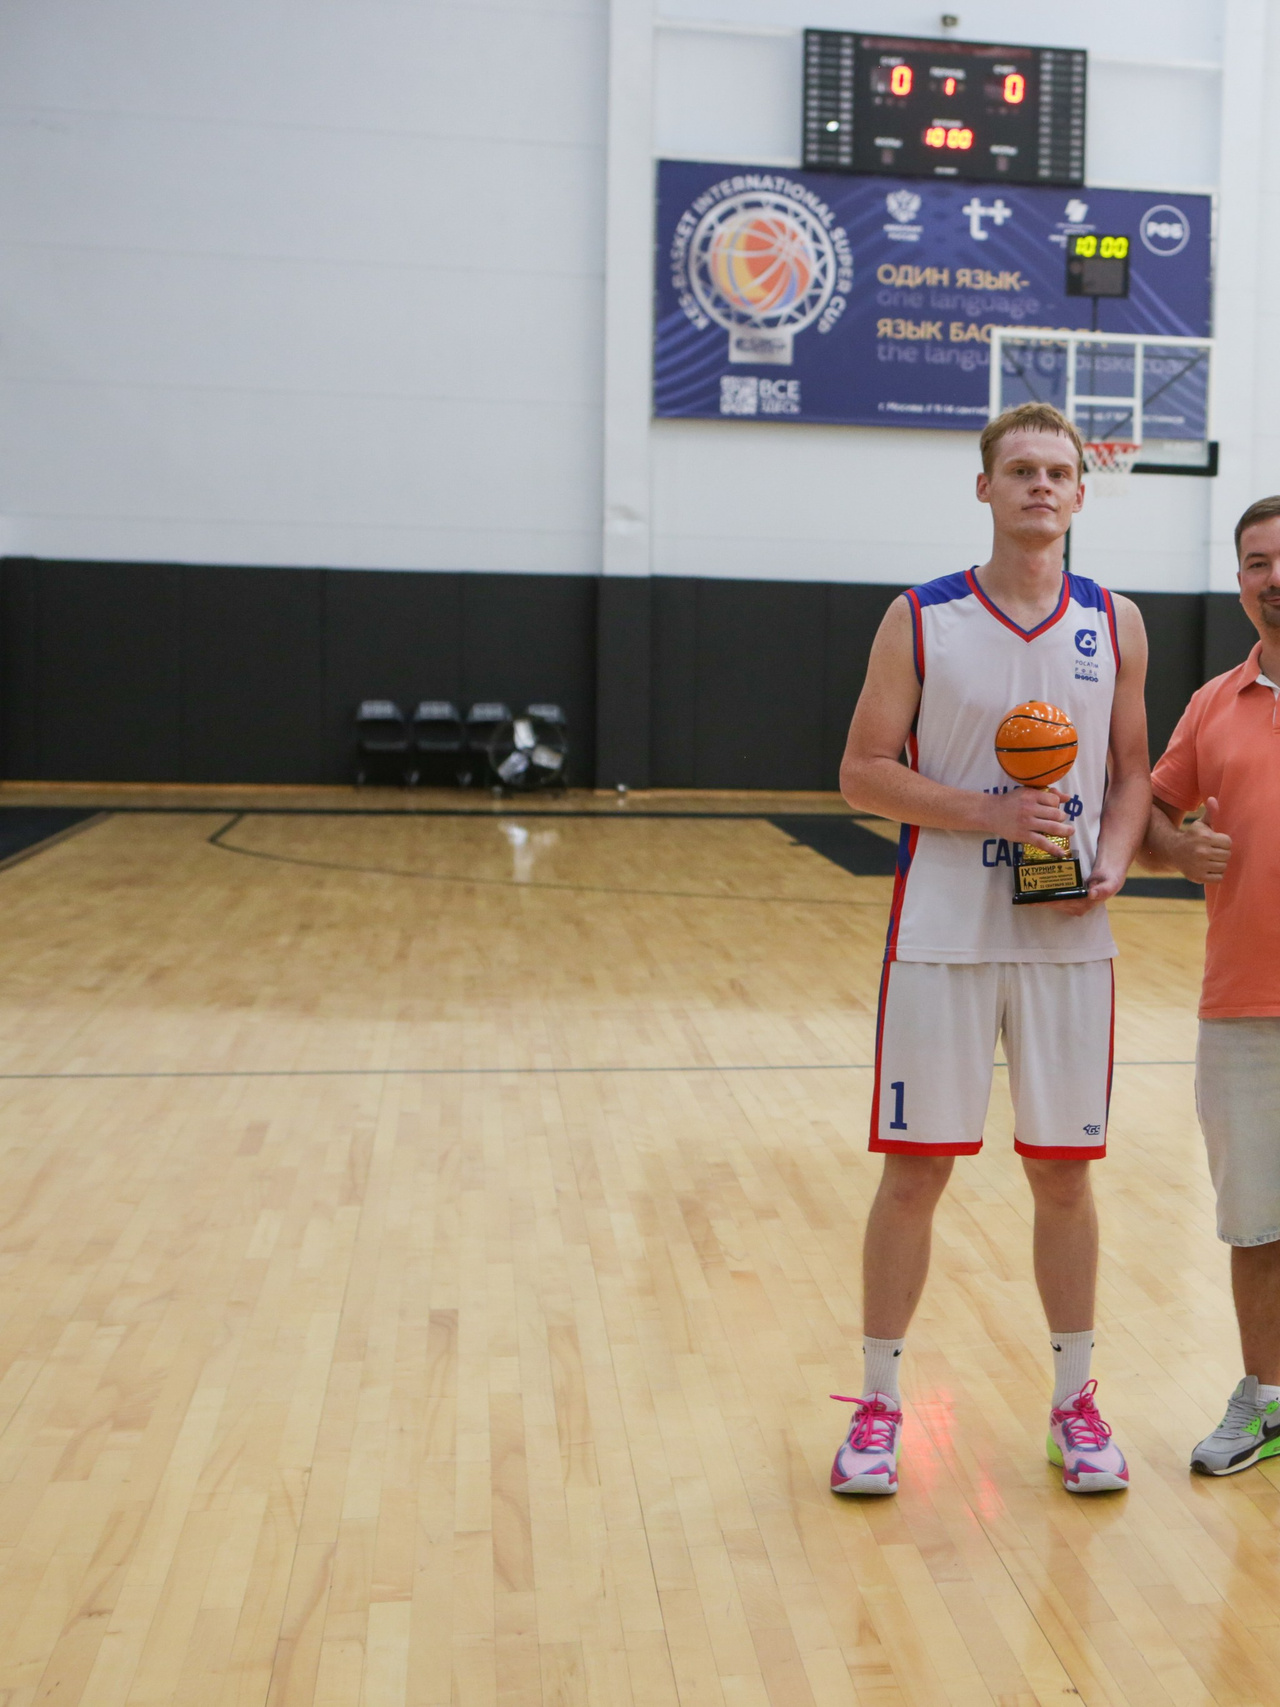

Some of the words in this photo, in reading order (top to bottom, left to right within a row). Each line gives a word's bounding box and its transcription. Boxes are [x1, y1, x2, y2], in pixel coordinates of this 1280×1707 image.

[891, 64, 912, 96] 0
[944, 77, 956, 96] 1
[1003, 73, 1025, 104] 0
[692, 174, 836, 228] INTERNATIONAL
[829, 226, 855, 294] SUPER
[877, 263, 950, 289] ОДИН
[955, 267, 1030, 291] ЯЗЫК-
[817, 295, 847, 334] CUP
[877, 289, 924, 308] one
[930, 289, 1040, 319] language
[877, 318, 943, 340] ЯЗЫК
[877, 340, 919, 363] the
[759, 378, 800, 401] ВСЕ
[1021, 868, 1031, 877] IX
[889, 1081, 908, 1131] 1
